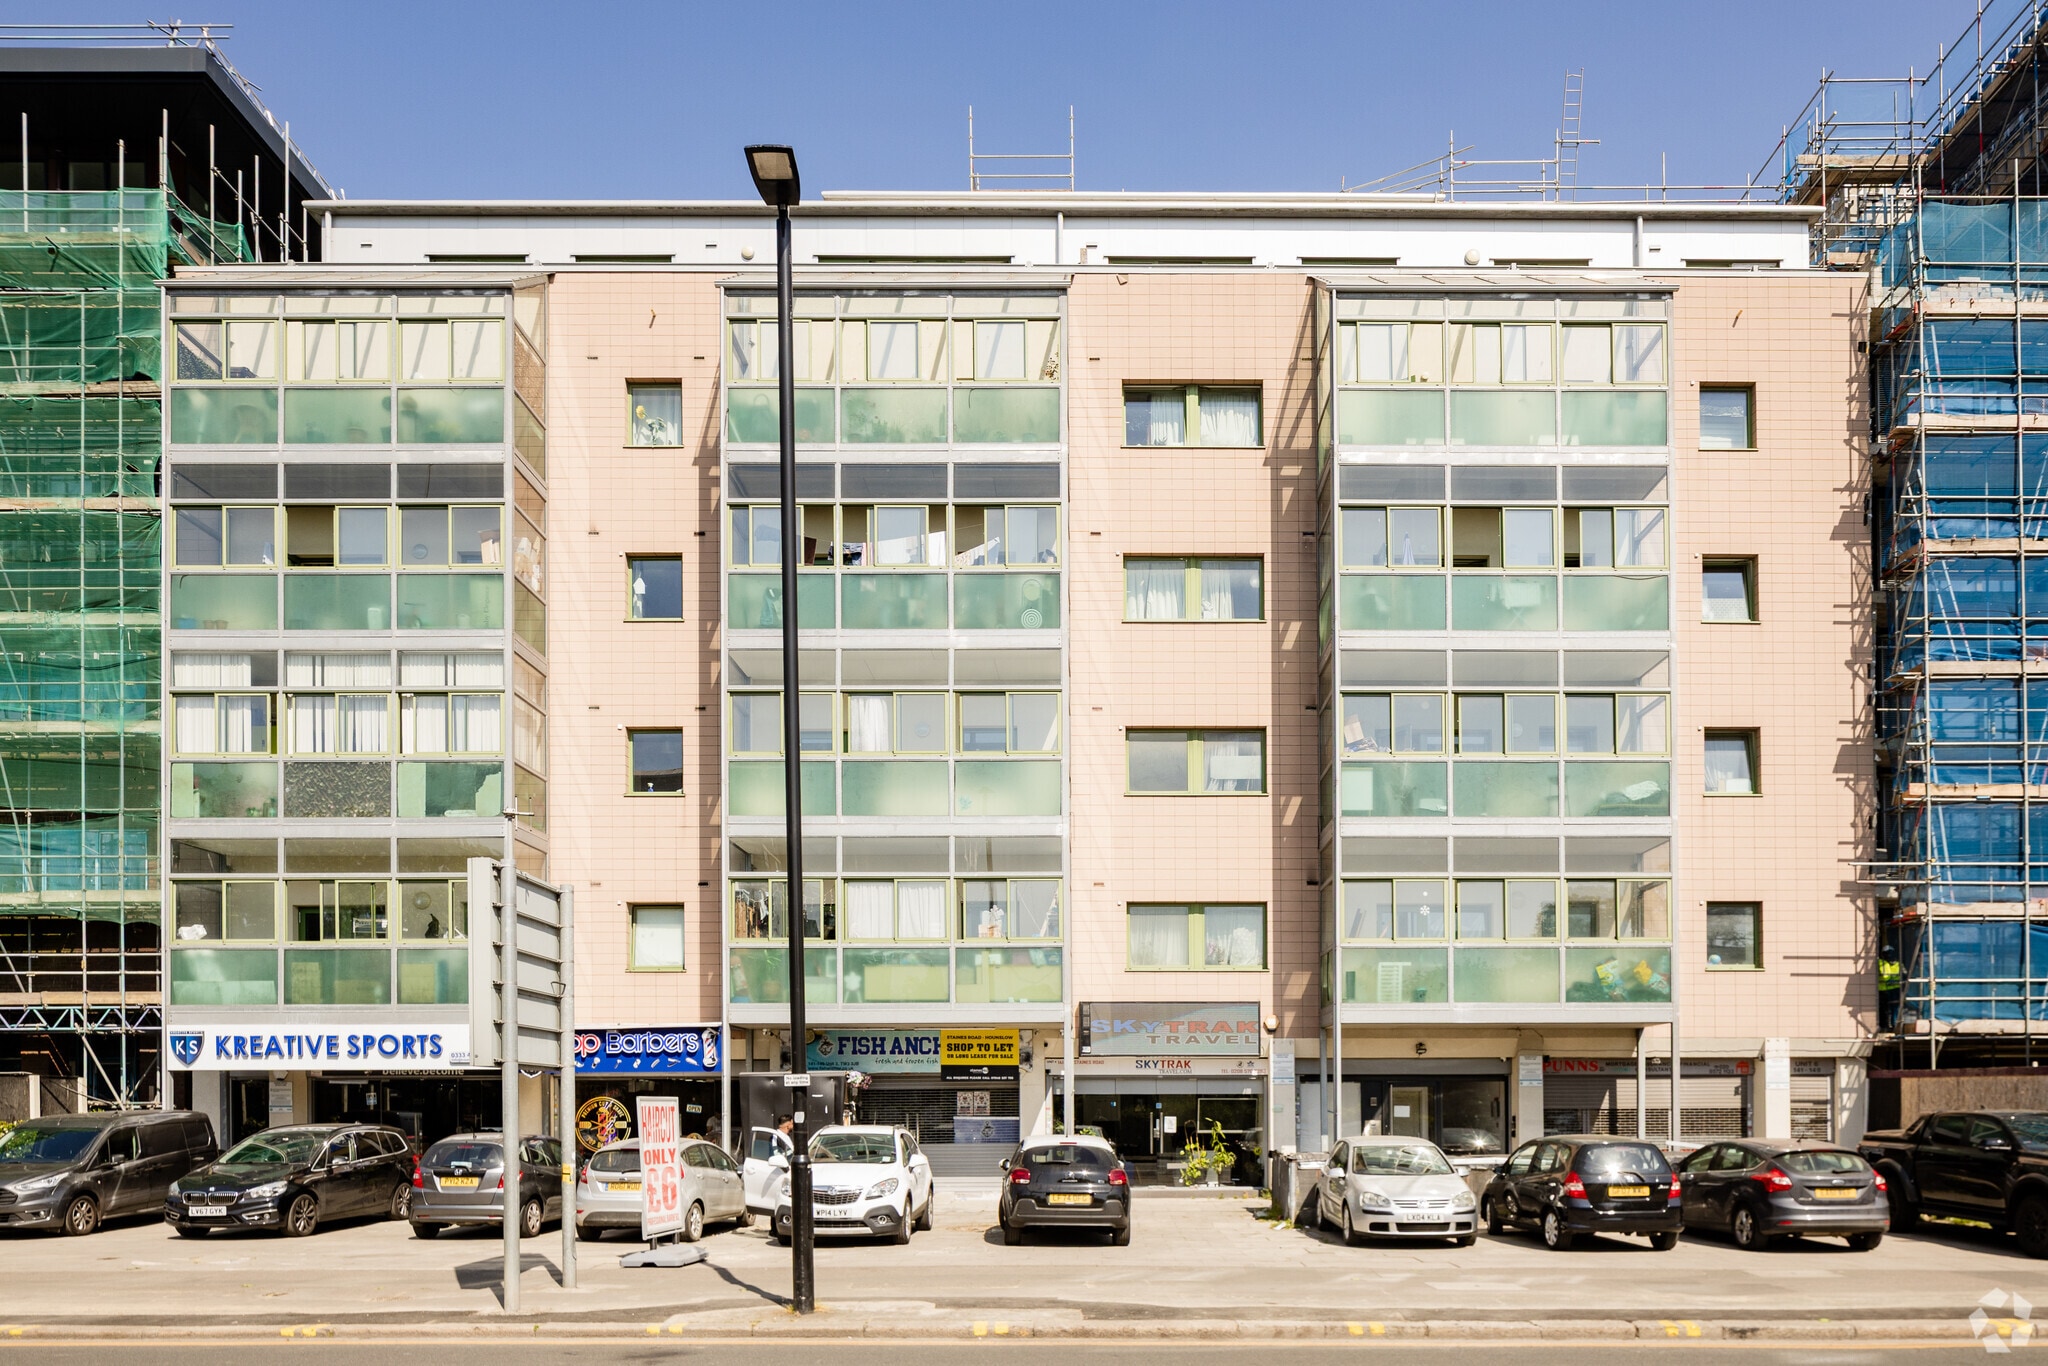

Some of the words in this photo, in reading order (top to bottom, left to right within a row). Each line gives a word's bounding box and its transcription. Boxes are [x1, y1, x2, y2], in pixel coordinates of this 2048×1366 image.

[1091, 1019, 1258, 1033] SKYTRAK
[215, 1035, 340, 1058] KREATIVE
[347, 1034, 443, 1058] SPORTS
[606, 1031, 700, 1054] Barbers
[837, 1036, 886, 1055] FISH
[889, 1036, 941, 1055] ANC
[947, 1043, 974, 1051] SHOP
[977, 1043, 990, 1051] TO
[994, 1043, 1014, 1051] LET
[1146, 1035, 1258, 1044] TRAVEL
[1135, 1059, 1192, 1069] SKYTRAK
[641, 1106, 675, 1143] HAIRCUT
[643, 1148, 676, 1165] ONLY
[646, 1166, 678, 1212] £6
